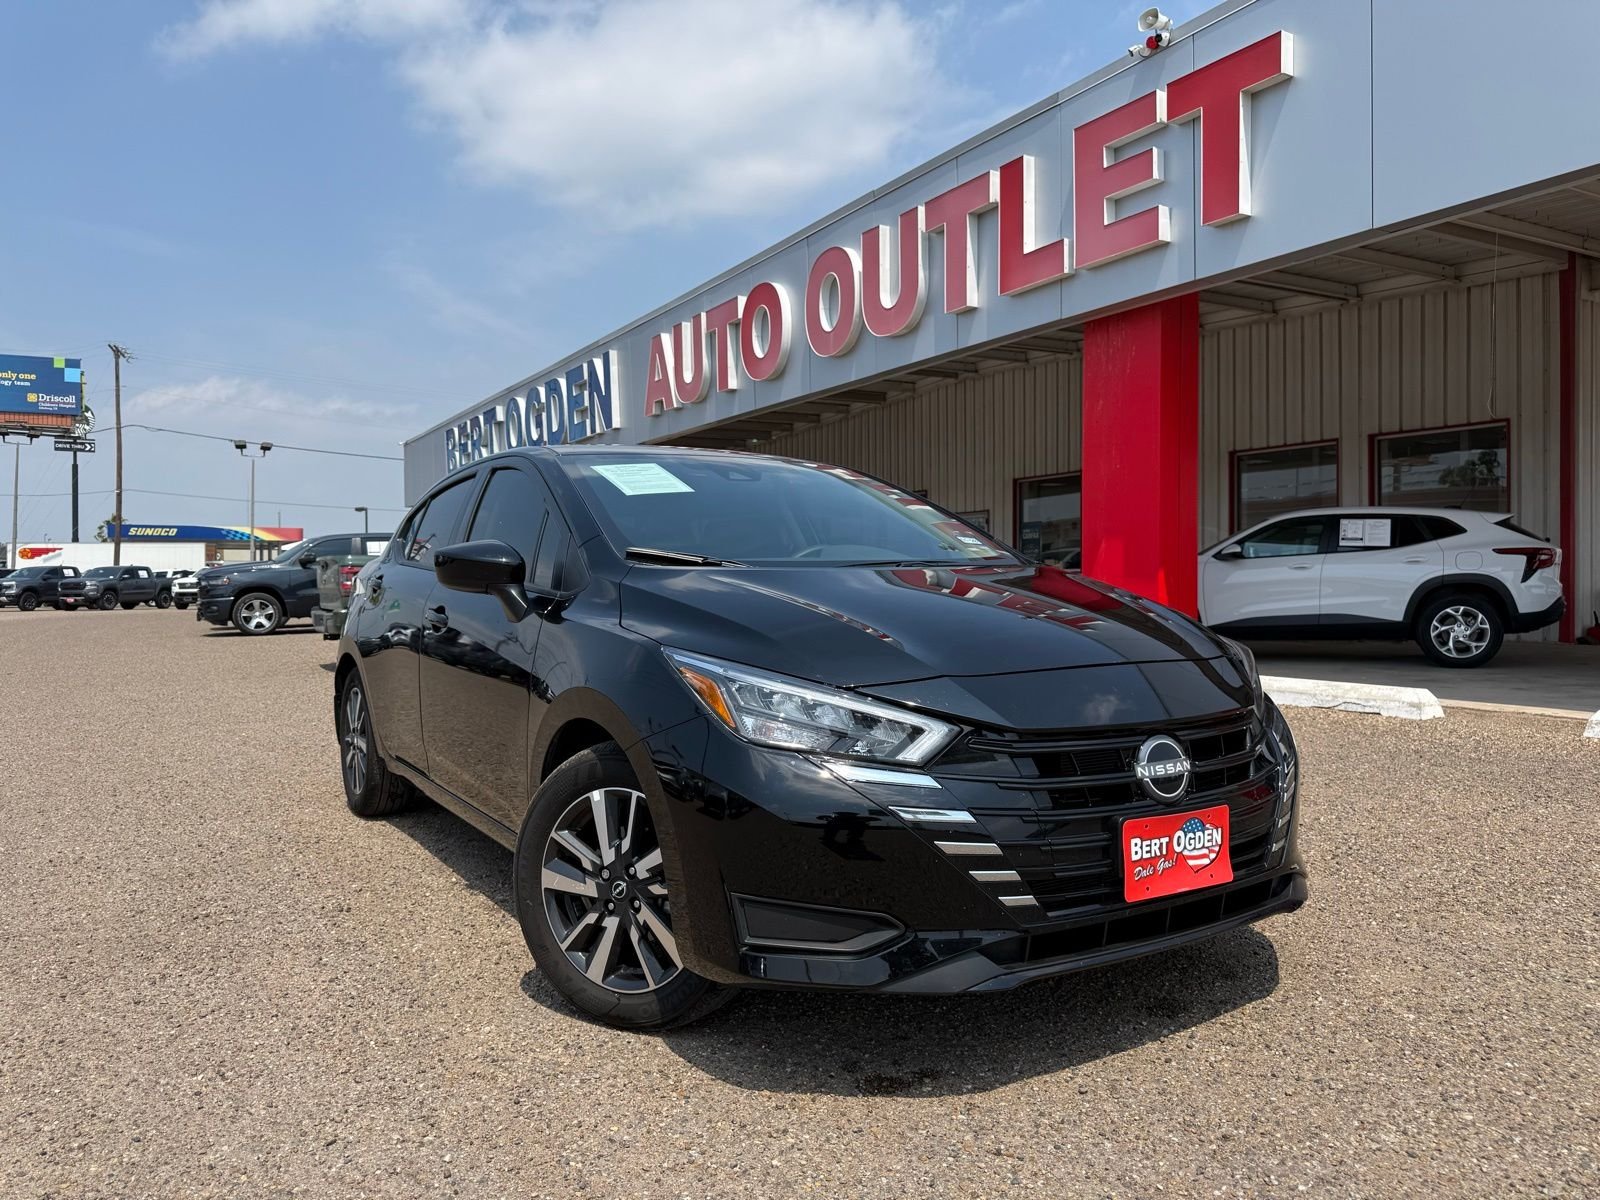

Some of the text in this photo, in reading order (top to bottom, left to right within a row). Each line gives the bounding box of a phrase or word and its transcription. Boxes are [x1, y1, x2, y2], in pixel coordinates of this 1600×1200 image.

[446, 30, 1293, 474] BERT OGDEN AUTO OUTLET
[38, 393, 76, 402] Driscoll
[128, 527, 178, 536] SUNOCO
[1137, 760, 1190, 777] NISSAN
[1130, 827, 1222, 861] BERT OGDEN
[1134, 853, 1177, 880] Dale Gas!
